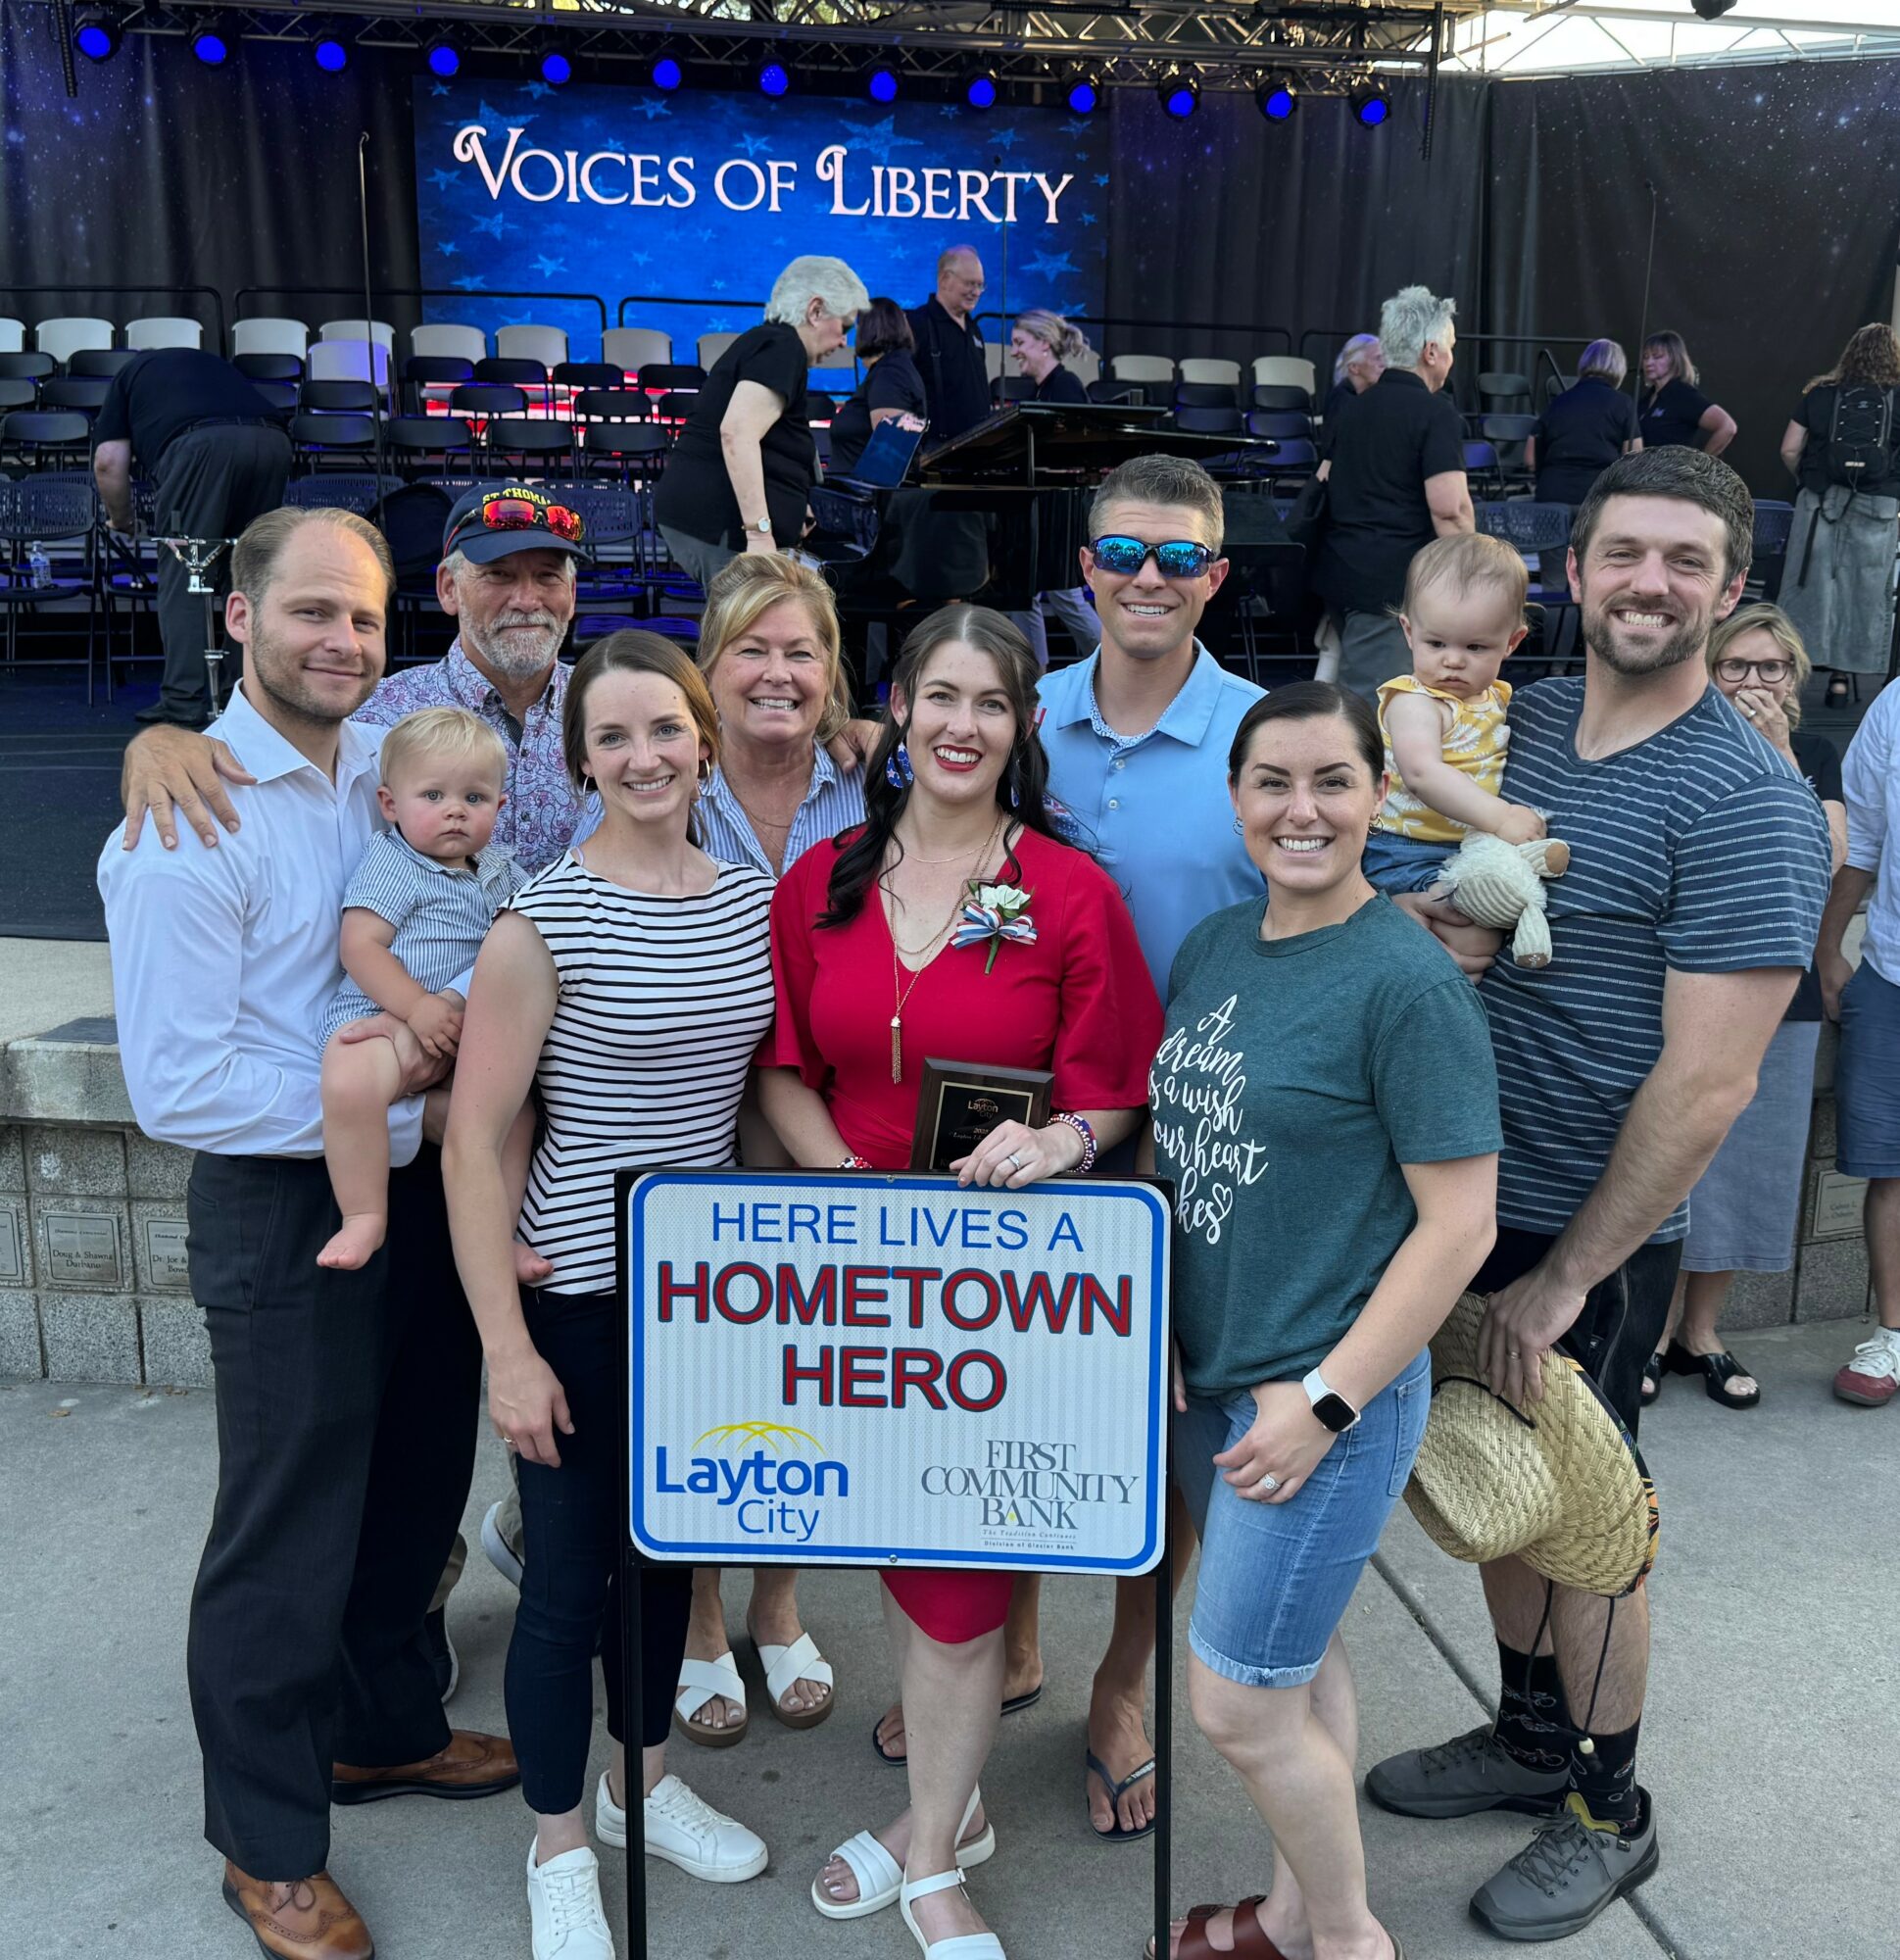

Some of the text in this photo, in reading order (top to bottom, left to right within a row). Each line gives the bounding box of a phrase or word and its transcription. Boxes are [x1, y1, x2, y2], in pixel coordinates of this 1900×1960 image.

[453, 125, 1075, 224] VOICES OF LIBERTY
[502, 488, 551, 505] THOMA
[1196, 994, 1238, 1046] A
[1156, 1027, 1243, 1086] dream
[967, 1100, 999, 1113] Layton
[1164, 1076, 1181, 1104] a
[1182, 1075, 1246, 1136] wish
[1151, 1116, 1268, 1186] our heart
[711, 1202, 1084, 1252] HERE LIVES A
[1176, 1166, 1226, 1245] kes
[52, 1250, 73, 1259] Doug
[84, 1250, 114, 1260] Shawna
[167, 1255, 178, 1264] Joe
[658, 1261, 1133, 1337] HOMETOWN
[782, 1345, 1007, 1412] HERO
[656, 1446, 849, 1505] Layton
[985, 1440, 1077, 1471] FIRST
[921, 1466, 1140, 1503] COMMUNITY
[738, 1498, 820, 1542] City
[980, 1497, 1079, 1529] BANK
